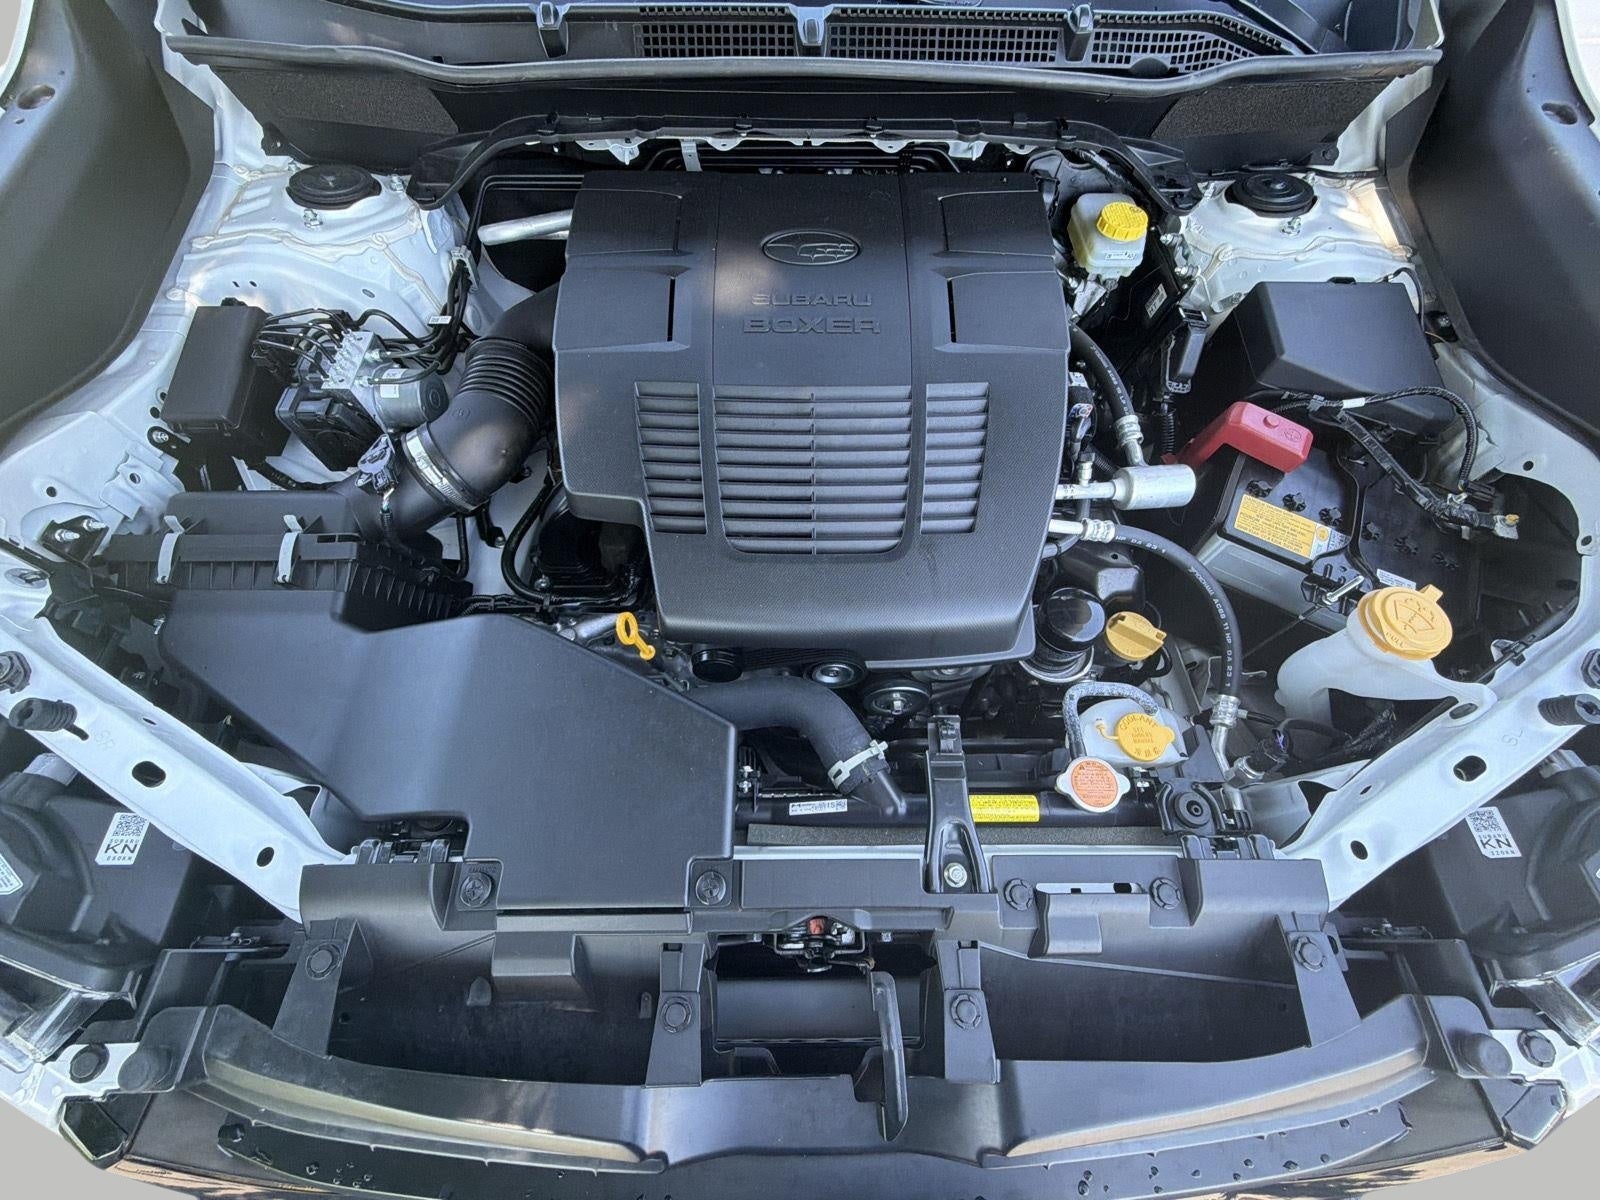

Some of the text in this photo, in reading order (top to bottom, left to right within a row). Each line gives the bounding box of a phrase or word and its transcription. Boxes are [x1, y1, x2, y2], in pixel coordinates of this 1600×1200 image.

[751, 293, 873, 307] SUBARU
[743, 317, 881, 334] BOXER
[1225, 632, 1232, 644] HP
[1227, 649, 1233, 662] DA
[1227, 665, 1233, 678] 23
[1119, 714, 1159, 730] COOLANT
[104, 843, 138, 854] KN
[1480, 838, 1512, 849] KN
